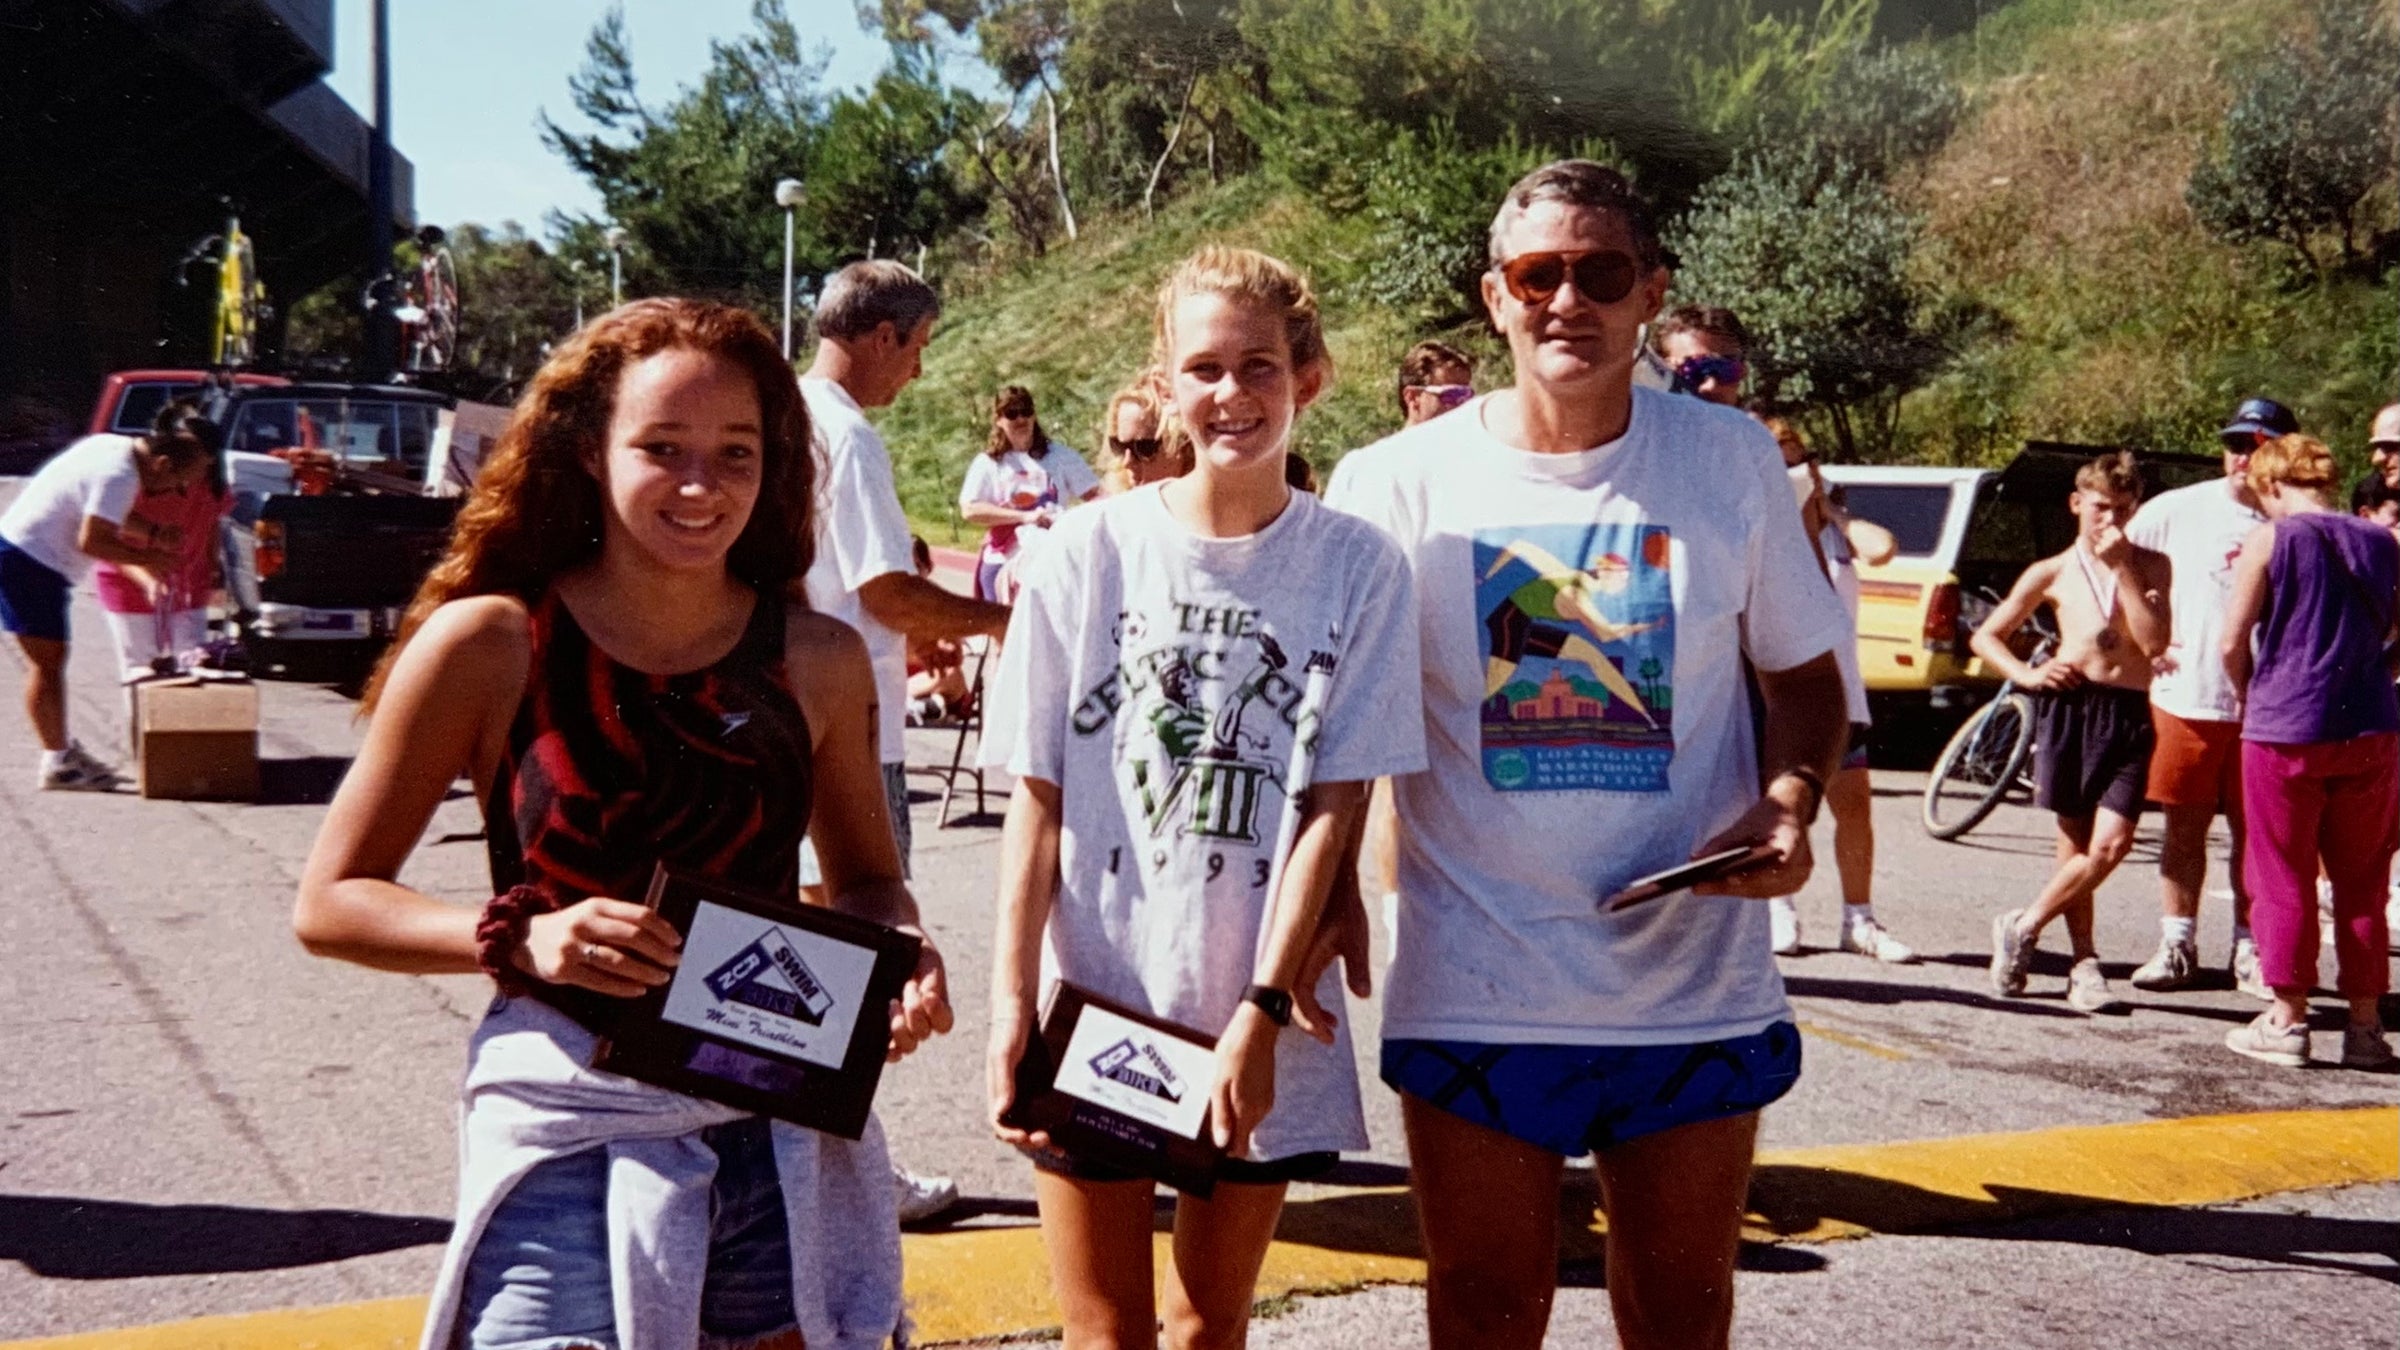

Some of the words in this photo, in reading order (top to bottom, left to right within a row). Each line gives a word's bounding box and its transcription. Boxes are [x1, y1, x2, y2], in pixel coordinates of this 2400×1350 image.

[1173, 602, 1260, 638] THE
[1072, 646, 1228, 735] CELTIC
[1536, 749, 1572, 760] LOS
[1580, 748, 1668, 762] ANGELES
[1537, 761, 1643, 774] MARATHON
[1129, 756, 1267, 842] VIII
[1537, 774, 1606, 785] MARCH
[774, 946, 820, 1001] SWIM
[706, 1008, 740, 1030] Mini
[749, 1020, 806, 1050] Triathlon
